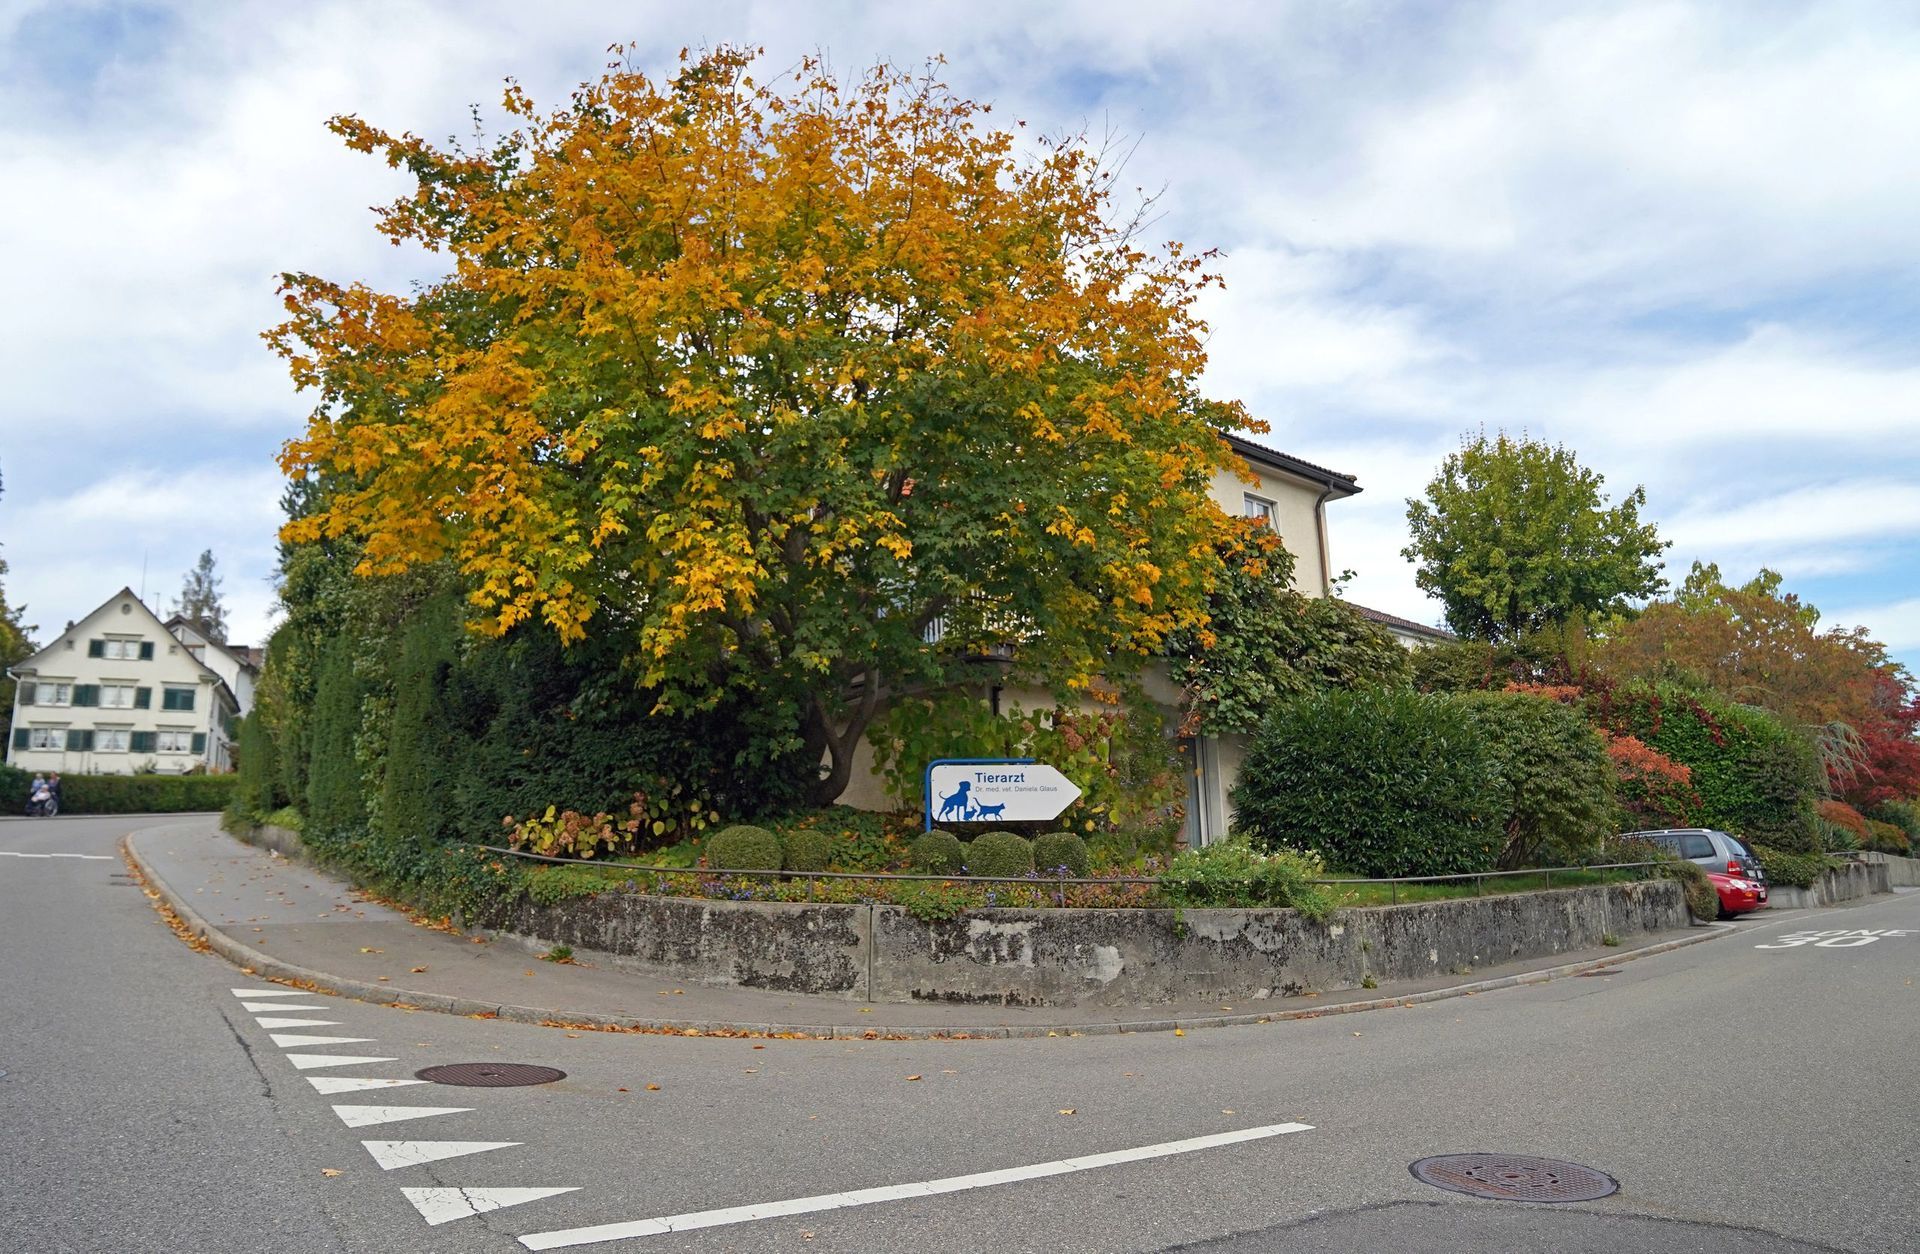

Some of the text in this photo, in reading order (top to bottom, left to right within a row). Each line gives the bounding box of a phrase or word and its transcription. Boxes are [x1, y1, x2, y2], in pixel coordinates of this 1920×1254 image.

[975, 772, 1025, 783] Tierarzt
[1777, 929, 1920, 938] ZONE
[1754, 935, 1880, 949] 30
